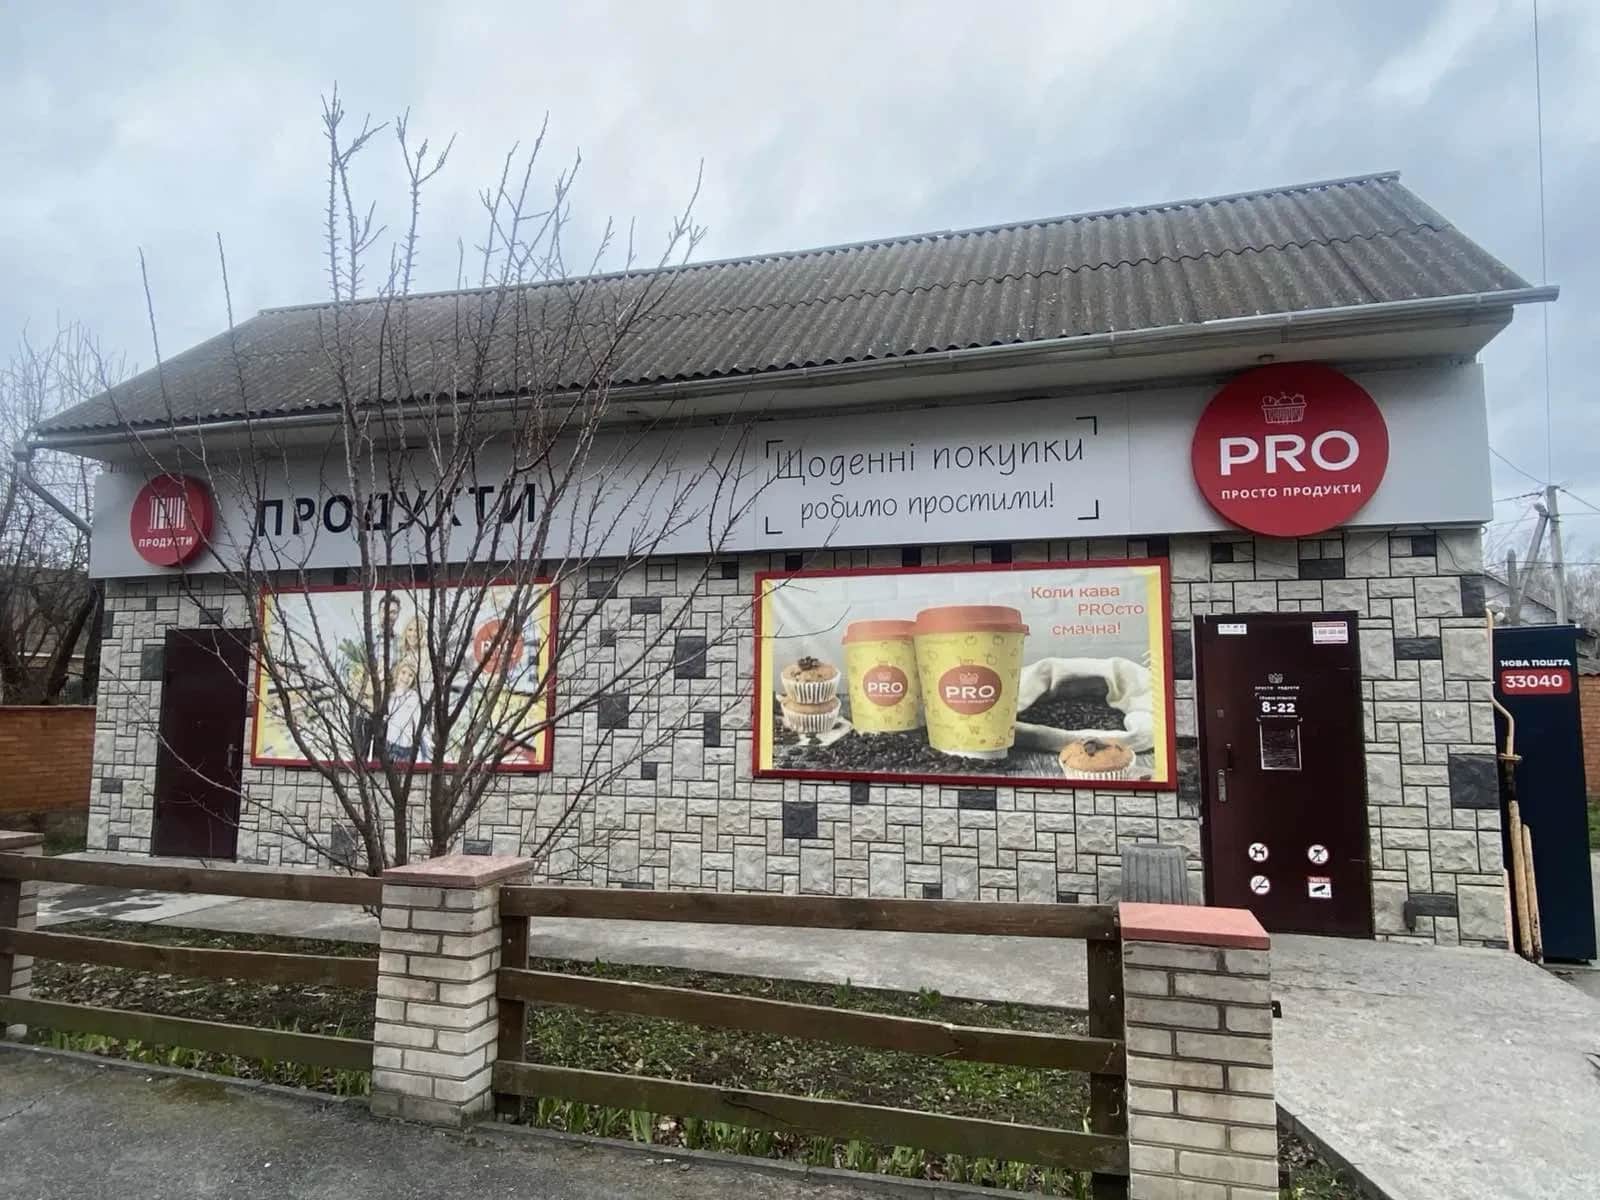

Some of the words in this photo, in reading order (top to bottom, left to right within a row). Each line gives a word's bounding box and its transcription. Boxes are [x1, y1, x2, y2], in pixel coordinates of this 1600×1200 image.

[1219, 430, 1360, 476] PRO
[776, 443, 915, 485] Щоденні
[932, 438, 1083, 475] покупки
[1221, 488, 1278, 500] ПРОСТО
[1283, 483, 1362, 498] ПРОДУКТИ
[801, 494, 898, 528] робимо
[908, 483, 1054, 522] простими!
[1031, 586, 1074, 599] Коли
[1079, 586, 1120, 598] кава
[1052, 622, 1121, 635] смачна!
[1500, 659, 1530, 667] НОВА
[1532, 659, 1571, 667] ПОШТА
[867, 682, 904, 693] PRO
[1505, 674, 1563, 688] 33040
[945, 685, 996, 699] PRO
[1261, 701, 1296, 713] 8-22
